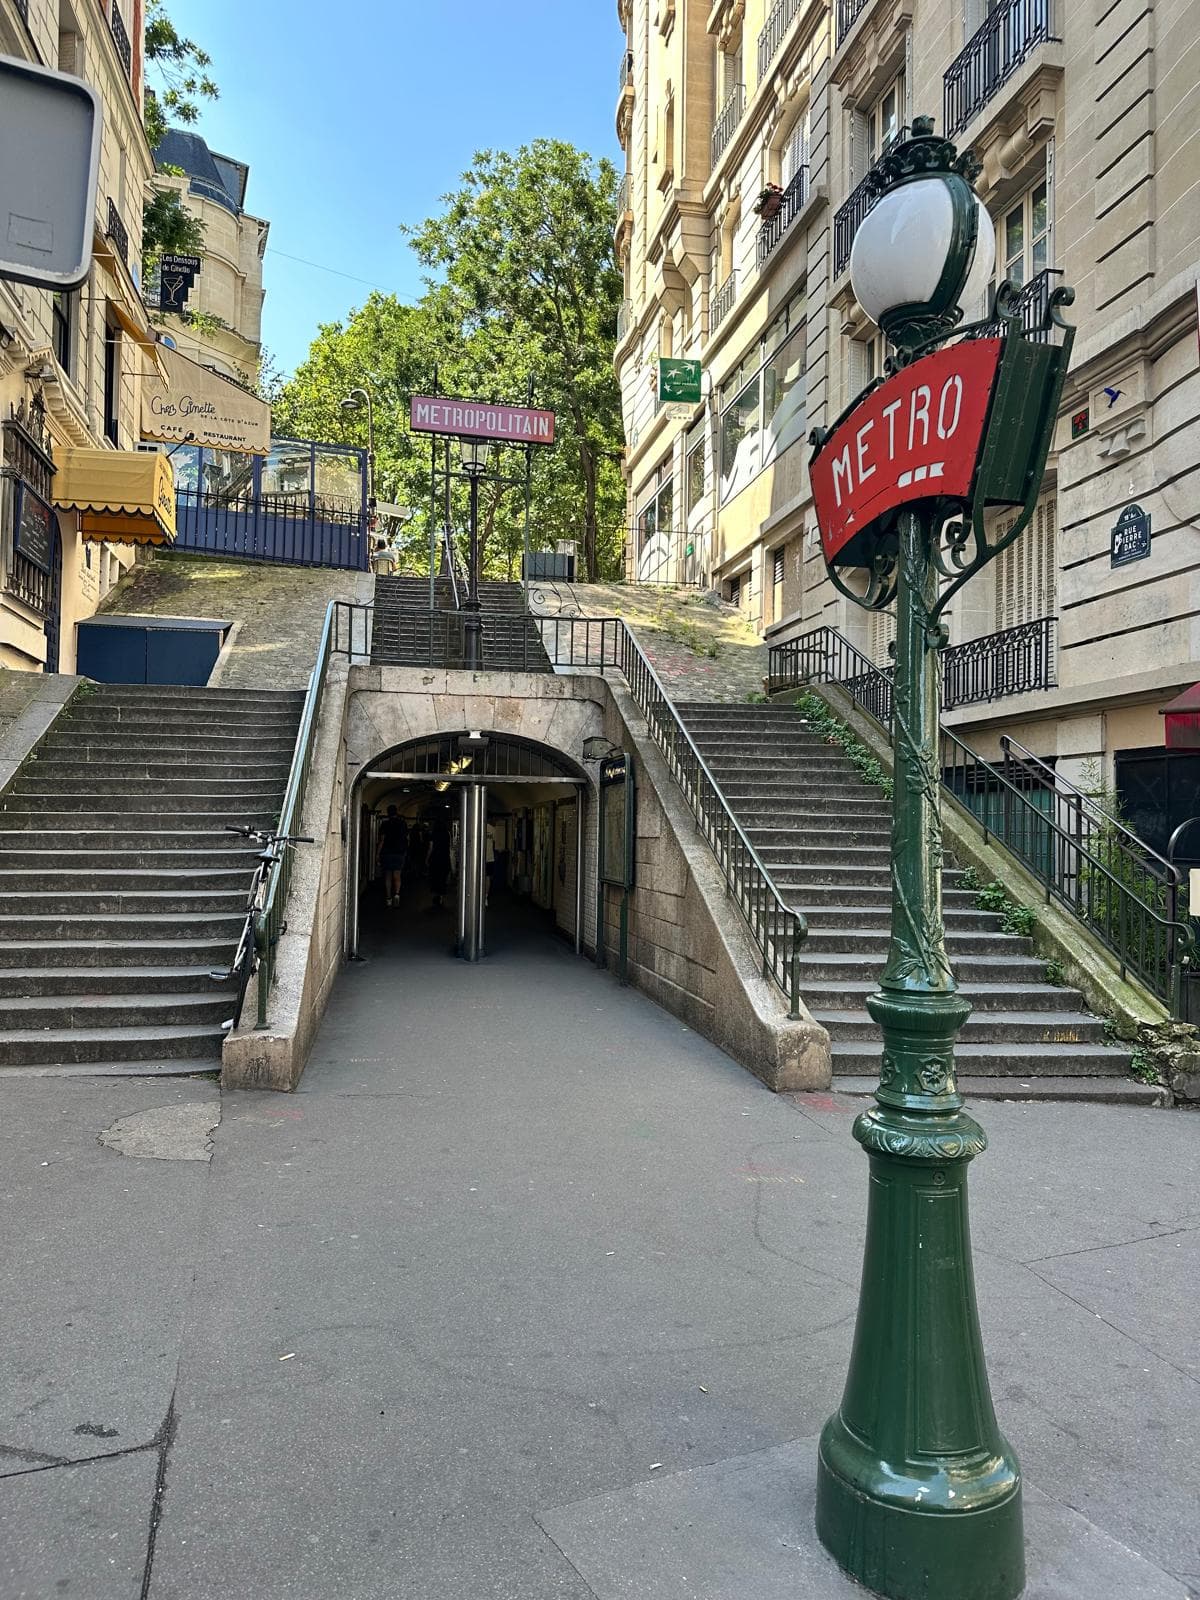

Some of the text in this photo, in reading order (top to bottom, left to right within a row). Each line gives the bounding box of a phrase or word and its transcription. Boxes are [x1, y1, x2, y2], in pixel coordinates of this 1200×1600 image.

[162, 254, 198, 266] Les Dessous
[151, 395, 216, 418] Chez Ginette
[416, 403, 549, 437] METROPOLITAIN
[203, 431, 247, 442] RESTAURANT
[831, 374, 963, 508] METRO
[1123, 525, 1137, 536] RUE
[1123, 541, 1137, 552] DAC
